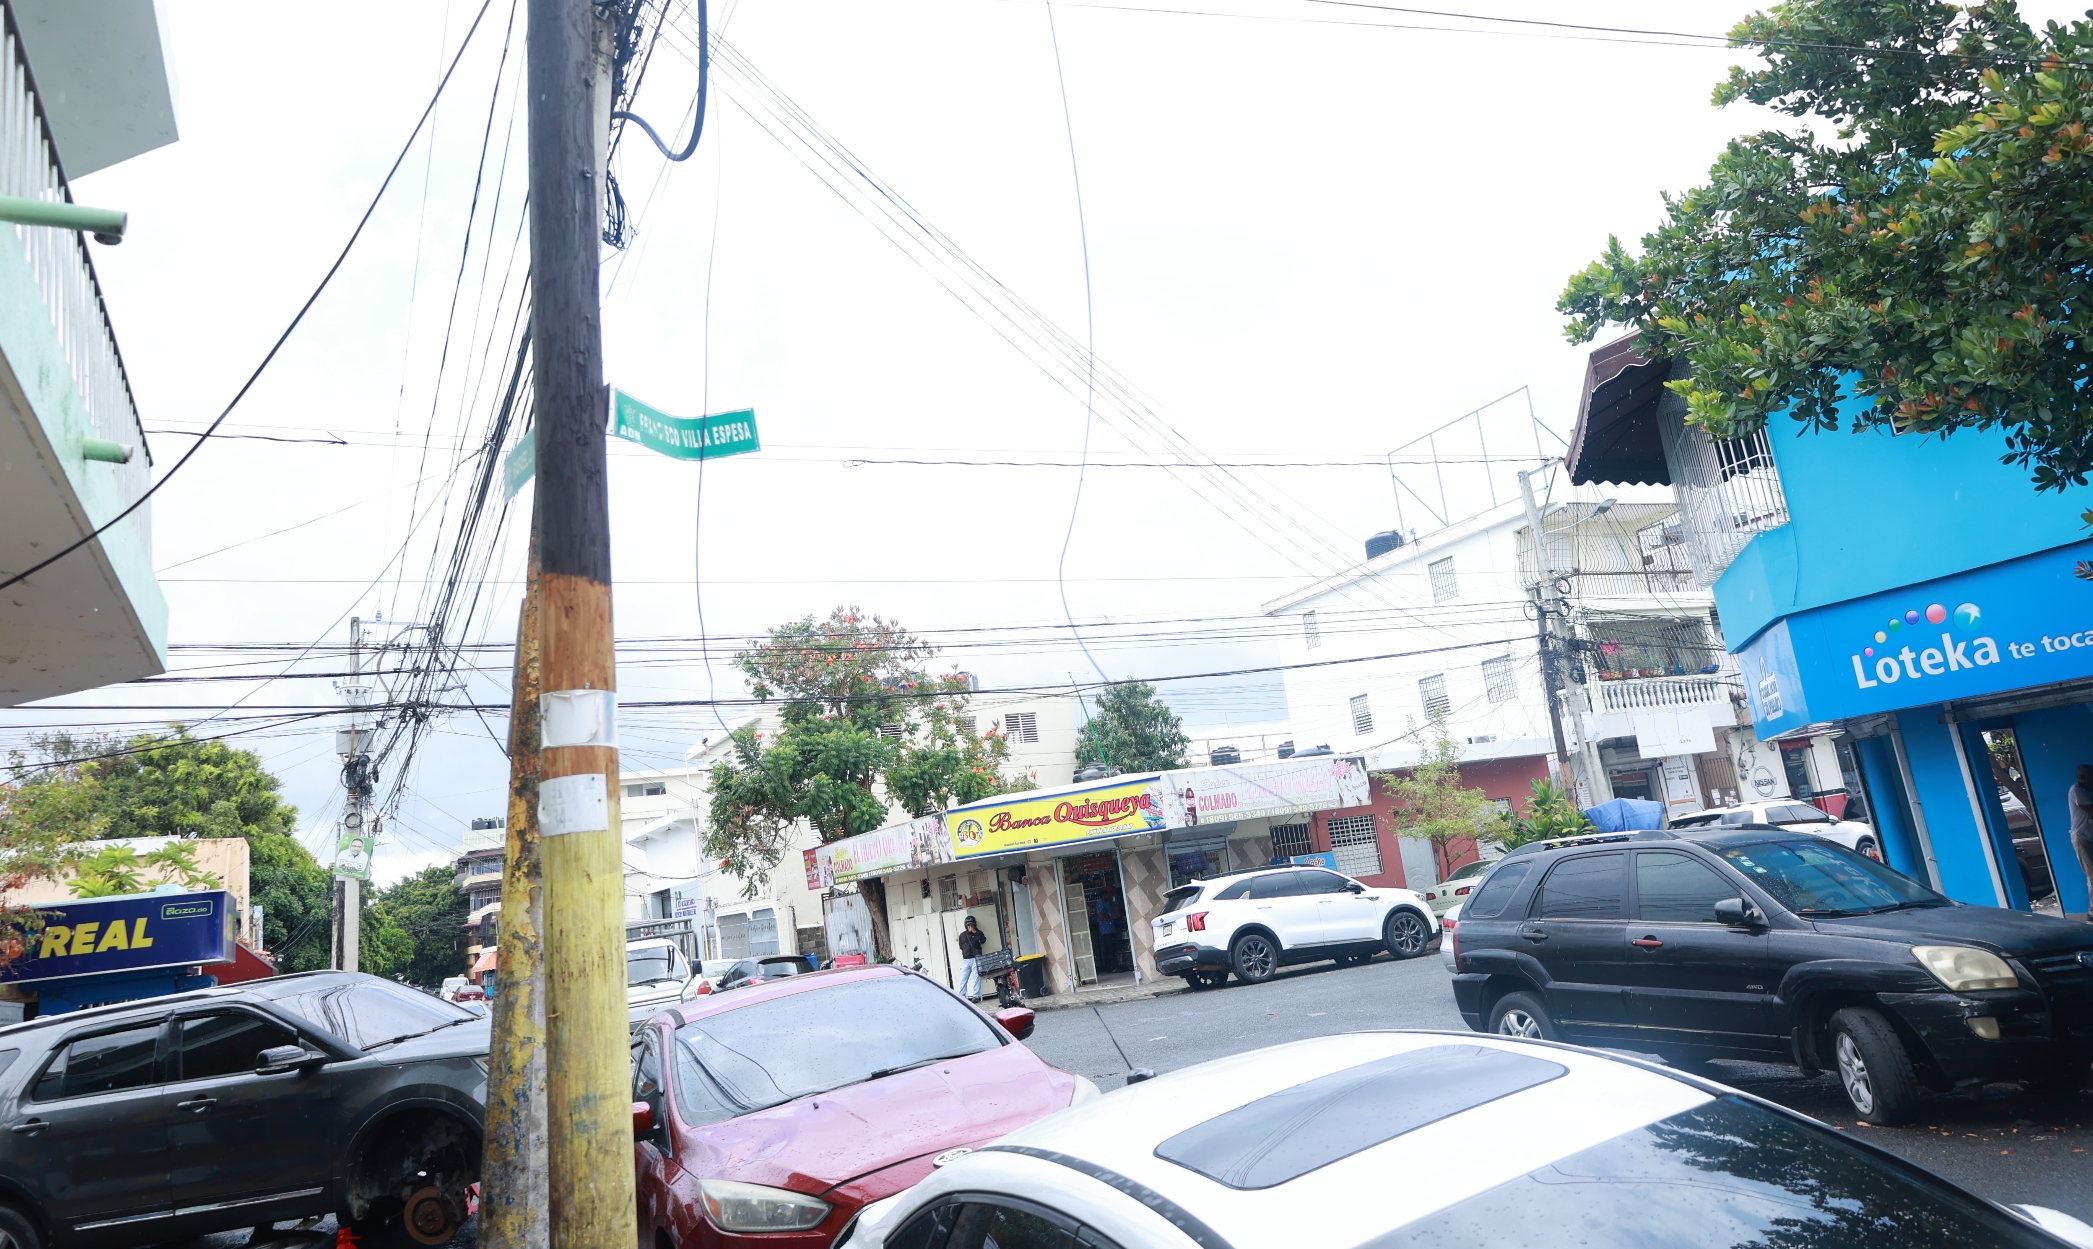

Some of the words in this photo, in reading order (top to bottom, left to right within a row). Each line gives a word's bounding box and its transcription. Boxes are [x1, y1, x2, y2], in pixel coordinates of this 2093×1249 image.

[620, 424, 642, 442] ADN
[712, 421, 752, 446] ESPESA
[1851, 632, 2001, 690] Loteka
[2008, 640, 2036, 660] te
[988, 811, 1052, 834] Banca
[1054, 792, 1151, 826] Quisqueya
[1198, 791, 1238, 812] COLMADO
[39, 917, 154, 959] REAL
